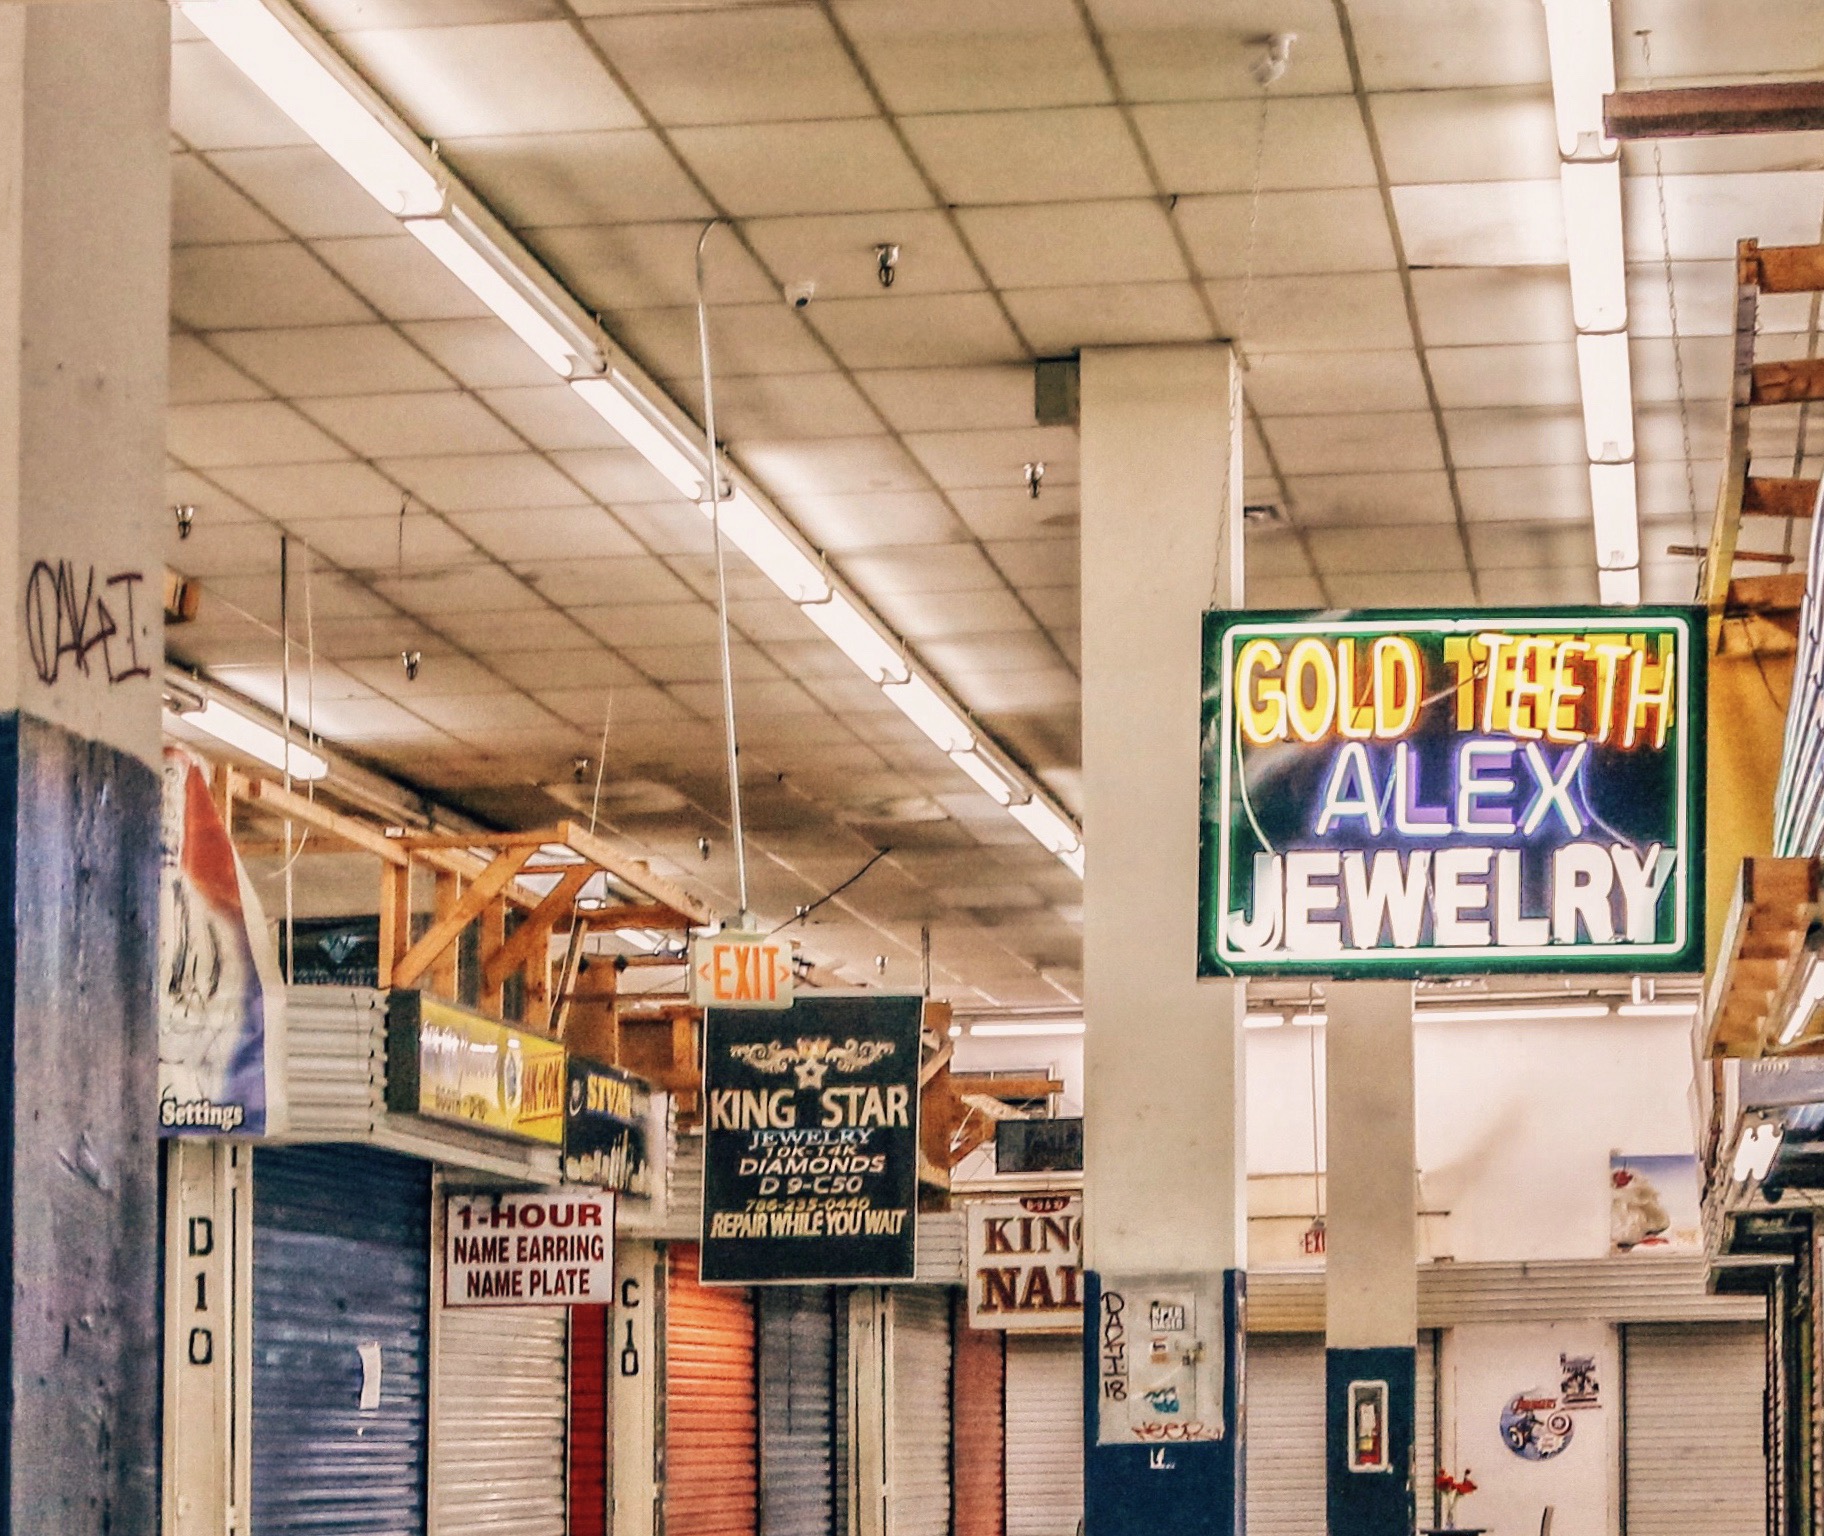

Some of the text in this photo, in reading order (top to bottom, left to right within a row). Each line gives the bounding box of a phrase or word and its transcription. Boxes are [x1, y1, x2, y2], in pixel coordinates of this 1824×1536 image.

[1236, 630, 1676, 748] GOLD TEETH
[1314, 740, 1590, 836] ALEX
[1226, 842, 1677, 952] JEWELRY
[713, 945, 779, 1001] EXIT
[161, 1098, 244, 1132] Settings
[710, 1084, 910, 1131] KING STAR
[748, 1128, 875, 1150] JEWELRY
[738, 1155, 886, 1177] DIAMONDS
[758, 1178, 780, 1196] D
[457, 1203, 603, 1231] 1-HOUR
[710, 1208, 908, 1238] REPAIR WHILE YOU WAIT
[454, 1234, 604, 1265] NAME EARRING
[467, 1268, 591, 1298] NAME PLATE
